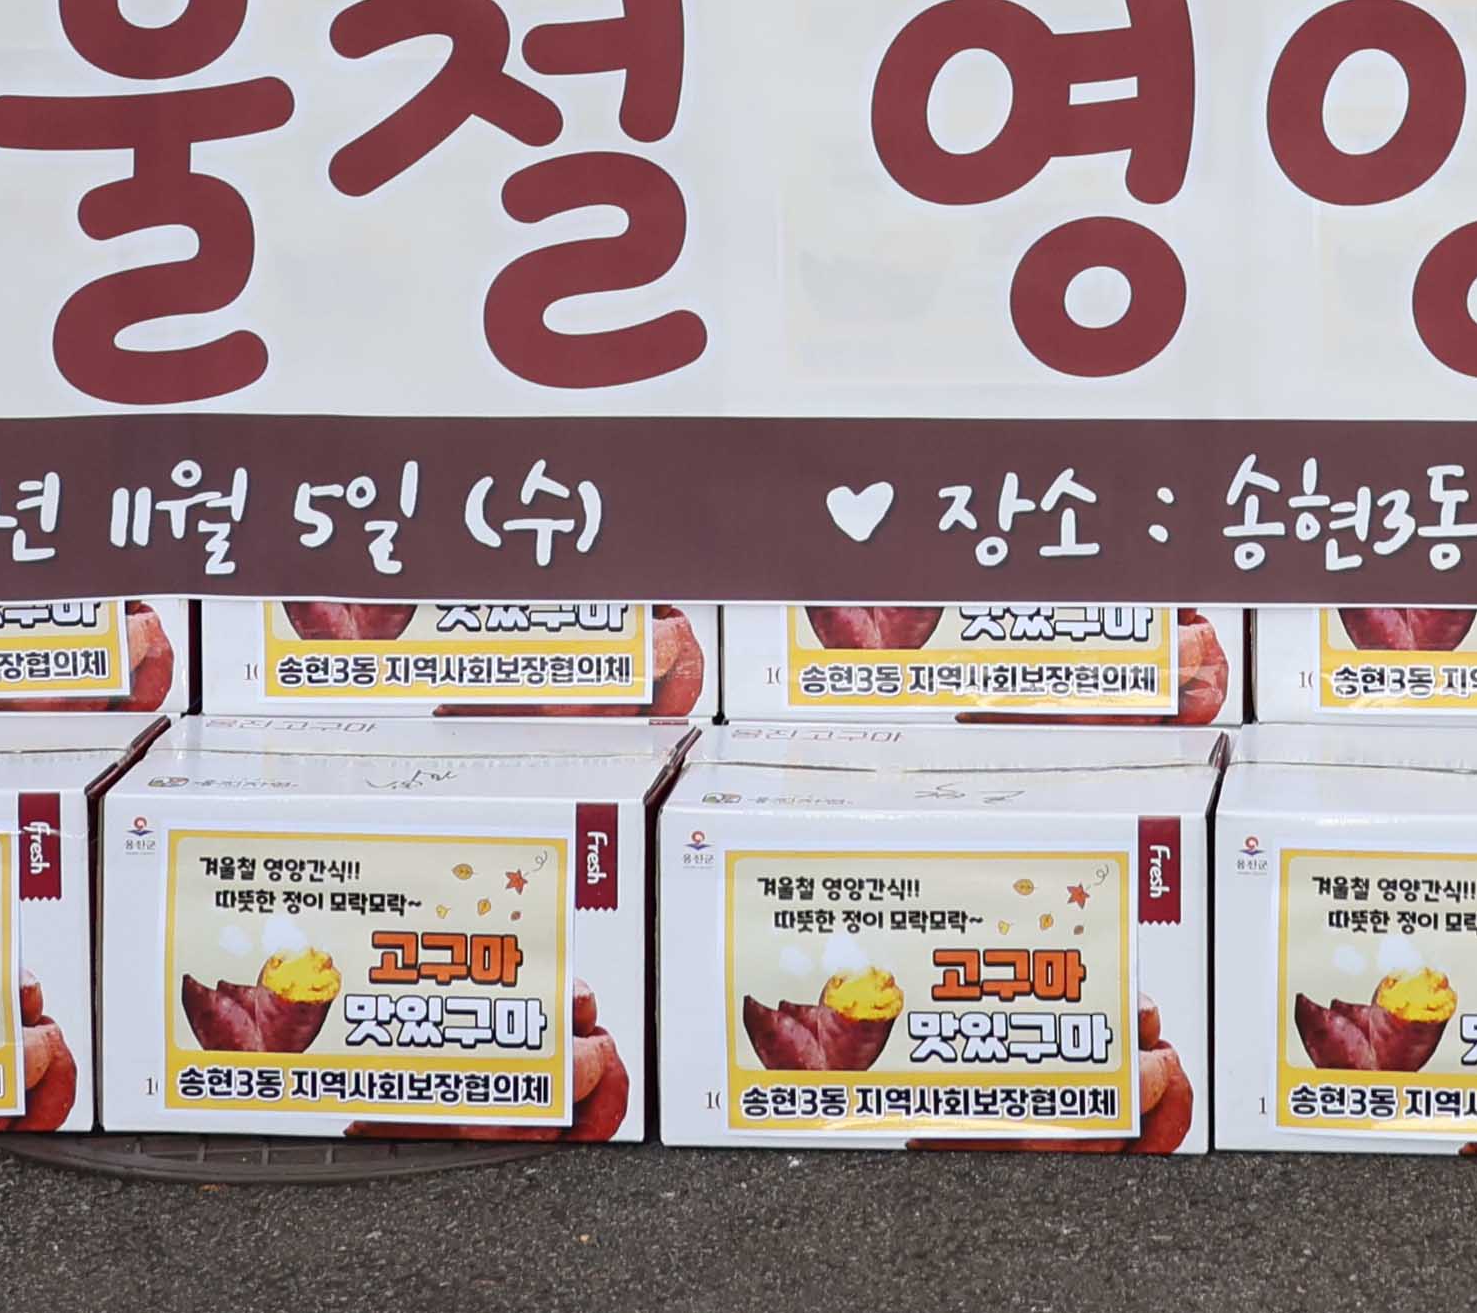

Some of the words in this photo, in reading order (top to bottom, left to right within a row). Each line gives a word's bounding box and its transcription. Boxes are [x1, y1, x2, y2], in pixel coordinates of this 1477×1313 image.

[110, 460, 248, 575] 11월
[294, 460, 418, 574] 5일
[464, 459, 602, 566] (수)
[938, 468, 1100, 566] 장소
[1148, 487, 1174, 543] :
[277, 655, 377, 684] 송현3동
[385, 655, 630, 685] 지역사회보장협의체
[800, 664, 901, 693] 송현3동
[909, 664, 1154, 694] 지역사회보장협의체
[1333, 666, 1433, 695] 송현3동
[198, 855, 257, 880] 겨울철
[263, 857, 360, 883] 영양간식!!
[586, 831, 609, 885] Fresh
[214, 888, 277, 913] 따뜻한
[282, 890, 324, 914] 정이
[330, 891, 422, 916] 모락모락~
[1311, 875, 1370, 900] 겨울철
[1377, 877, 1476, 903] 영양간식!!
[1327, 908, 1391, 933] 따뜻한
[1396, 910, 1439, 934] 정이
[370, 930, 523, 987] 고구마
[933, 947, 1086, 1002] 고구마
[344, 994, 547, 1049] 맛있구마
[907, 1011, 1112, 1063] 맛있구마
[178, 1067, 283, 1098] 송현3동
[291, 1069, 549, 1104] 지역사회보장협의체
[741, 1086, 848, 1116] 송현3동
[856, 1086, 1116, 1117] 지역사회보장협의체
[1290, 1085, 1396, 1117] 송현3동
